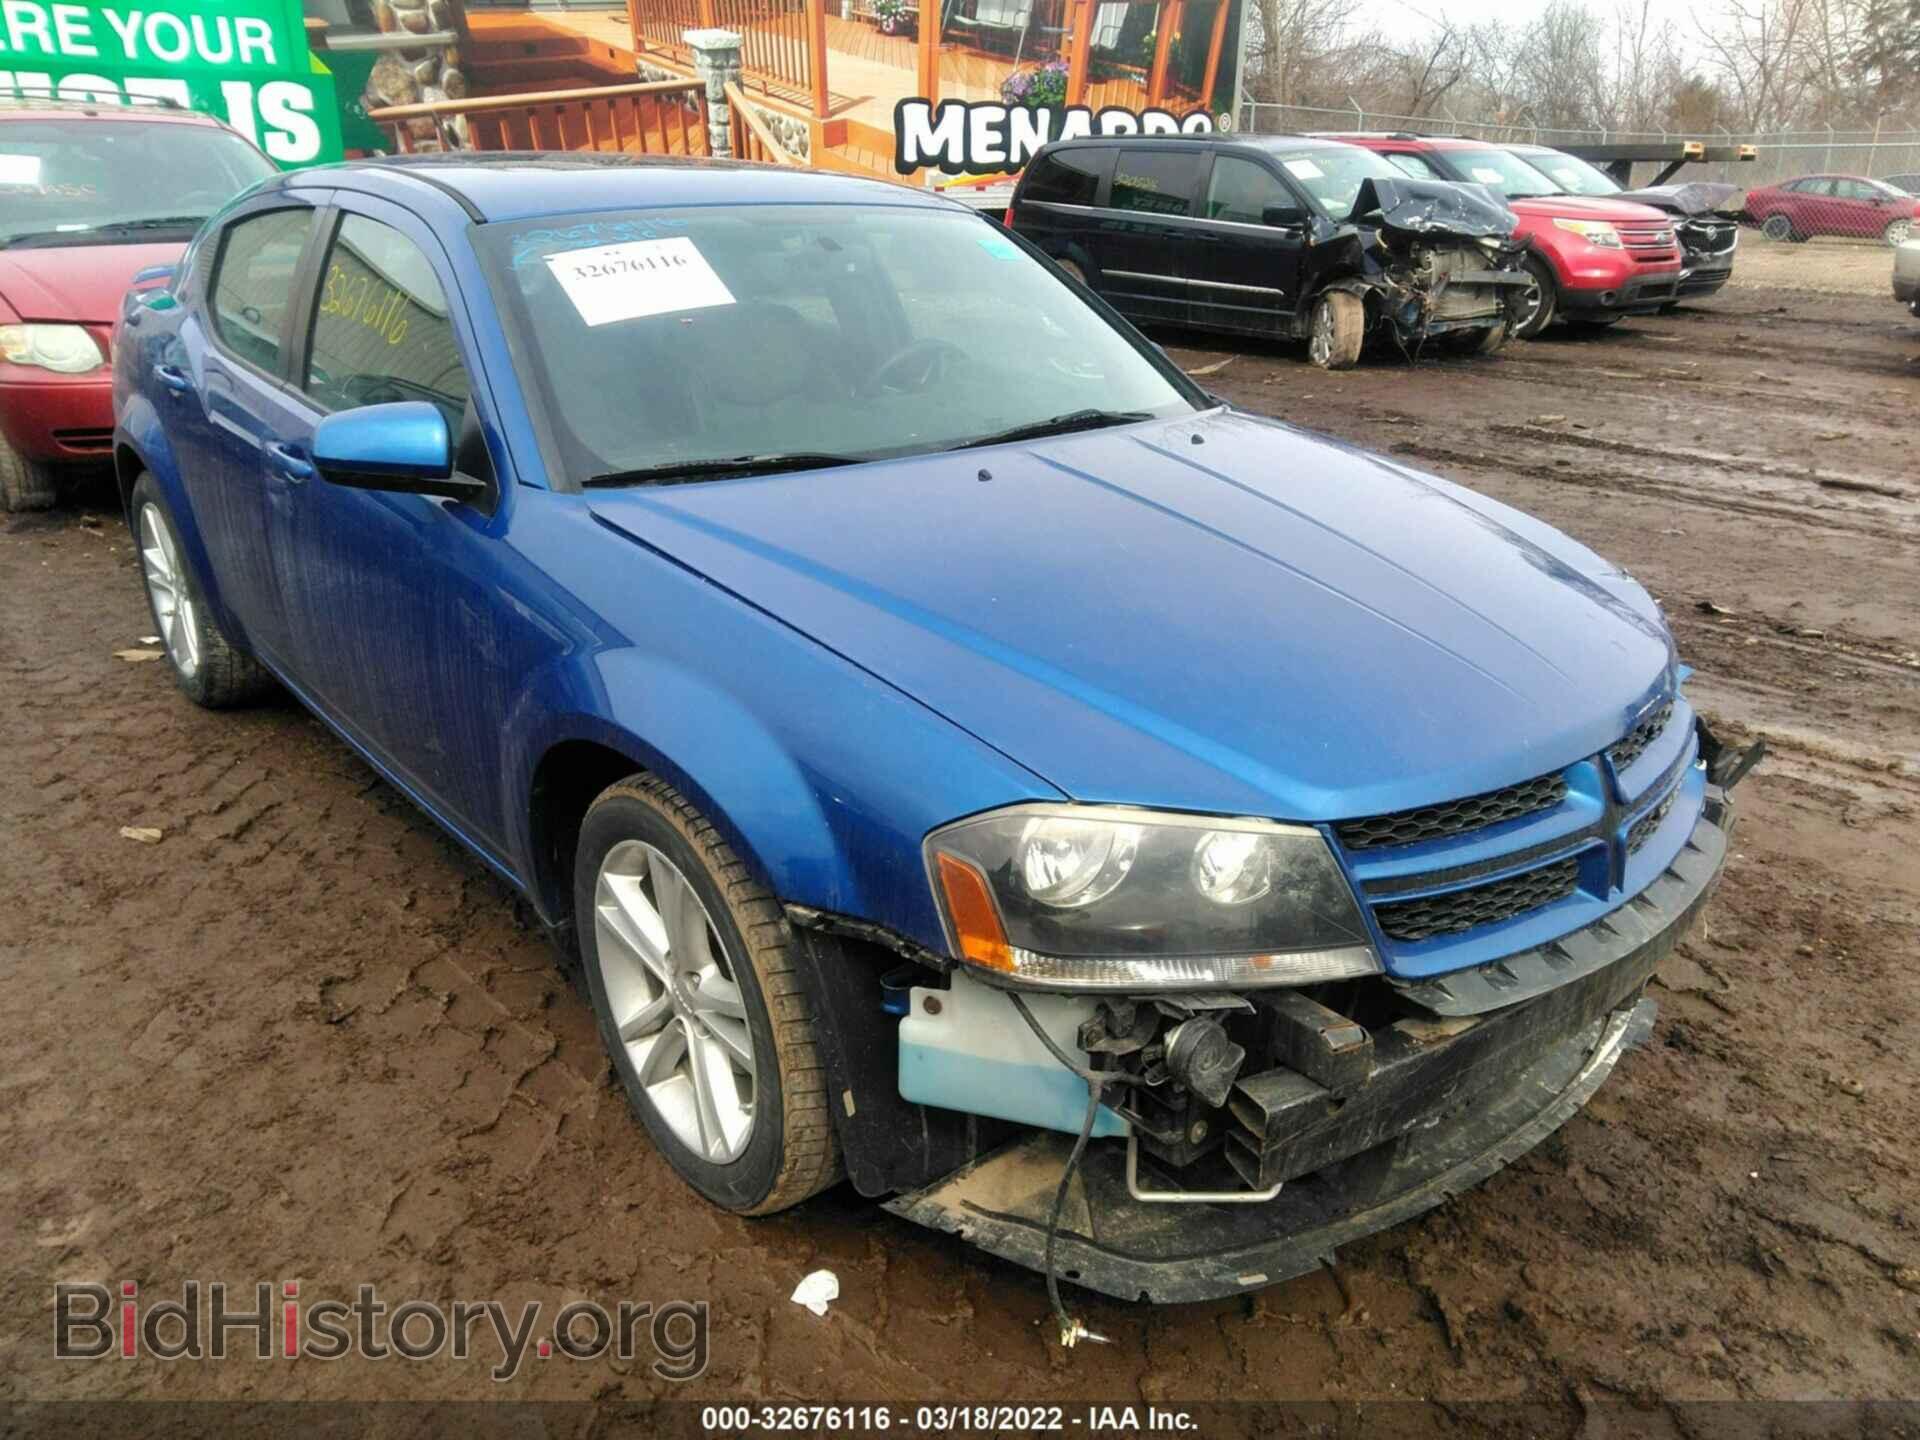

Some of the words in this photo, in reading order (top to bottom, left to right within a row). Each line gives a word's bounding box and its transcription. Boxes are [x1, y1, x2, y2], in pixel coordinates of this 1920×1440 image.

[0, 0, 99, 57] RE
[103, 8, 277, 65] YOUR
[220, 80, 321, 163] IS
[573, 255, 687, 280] 32676116
